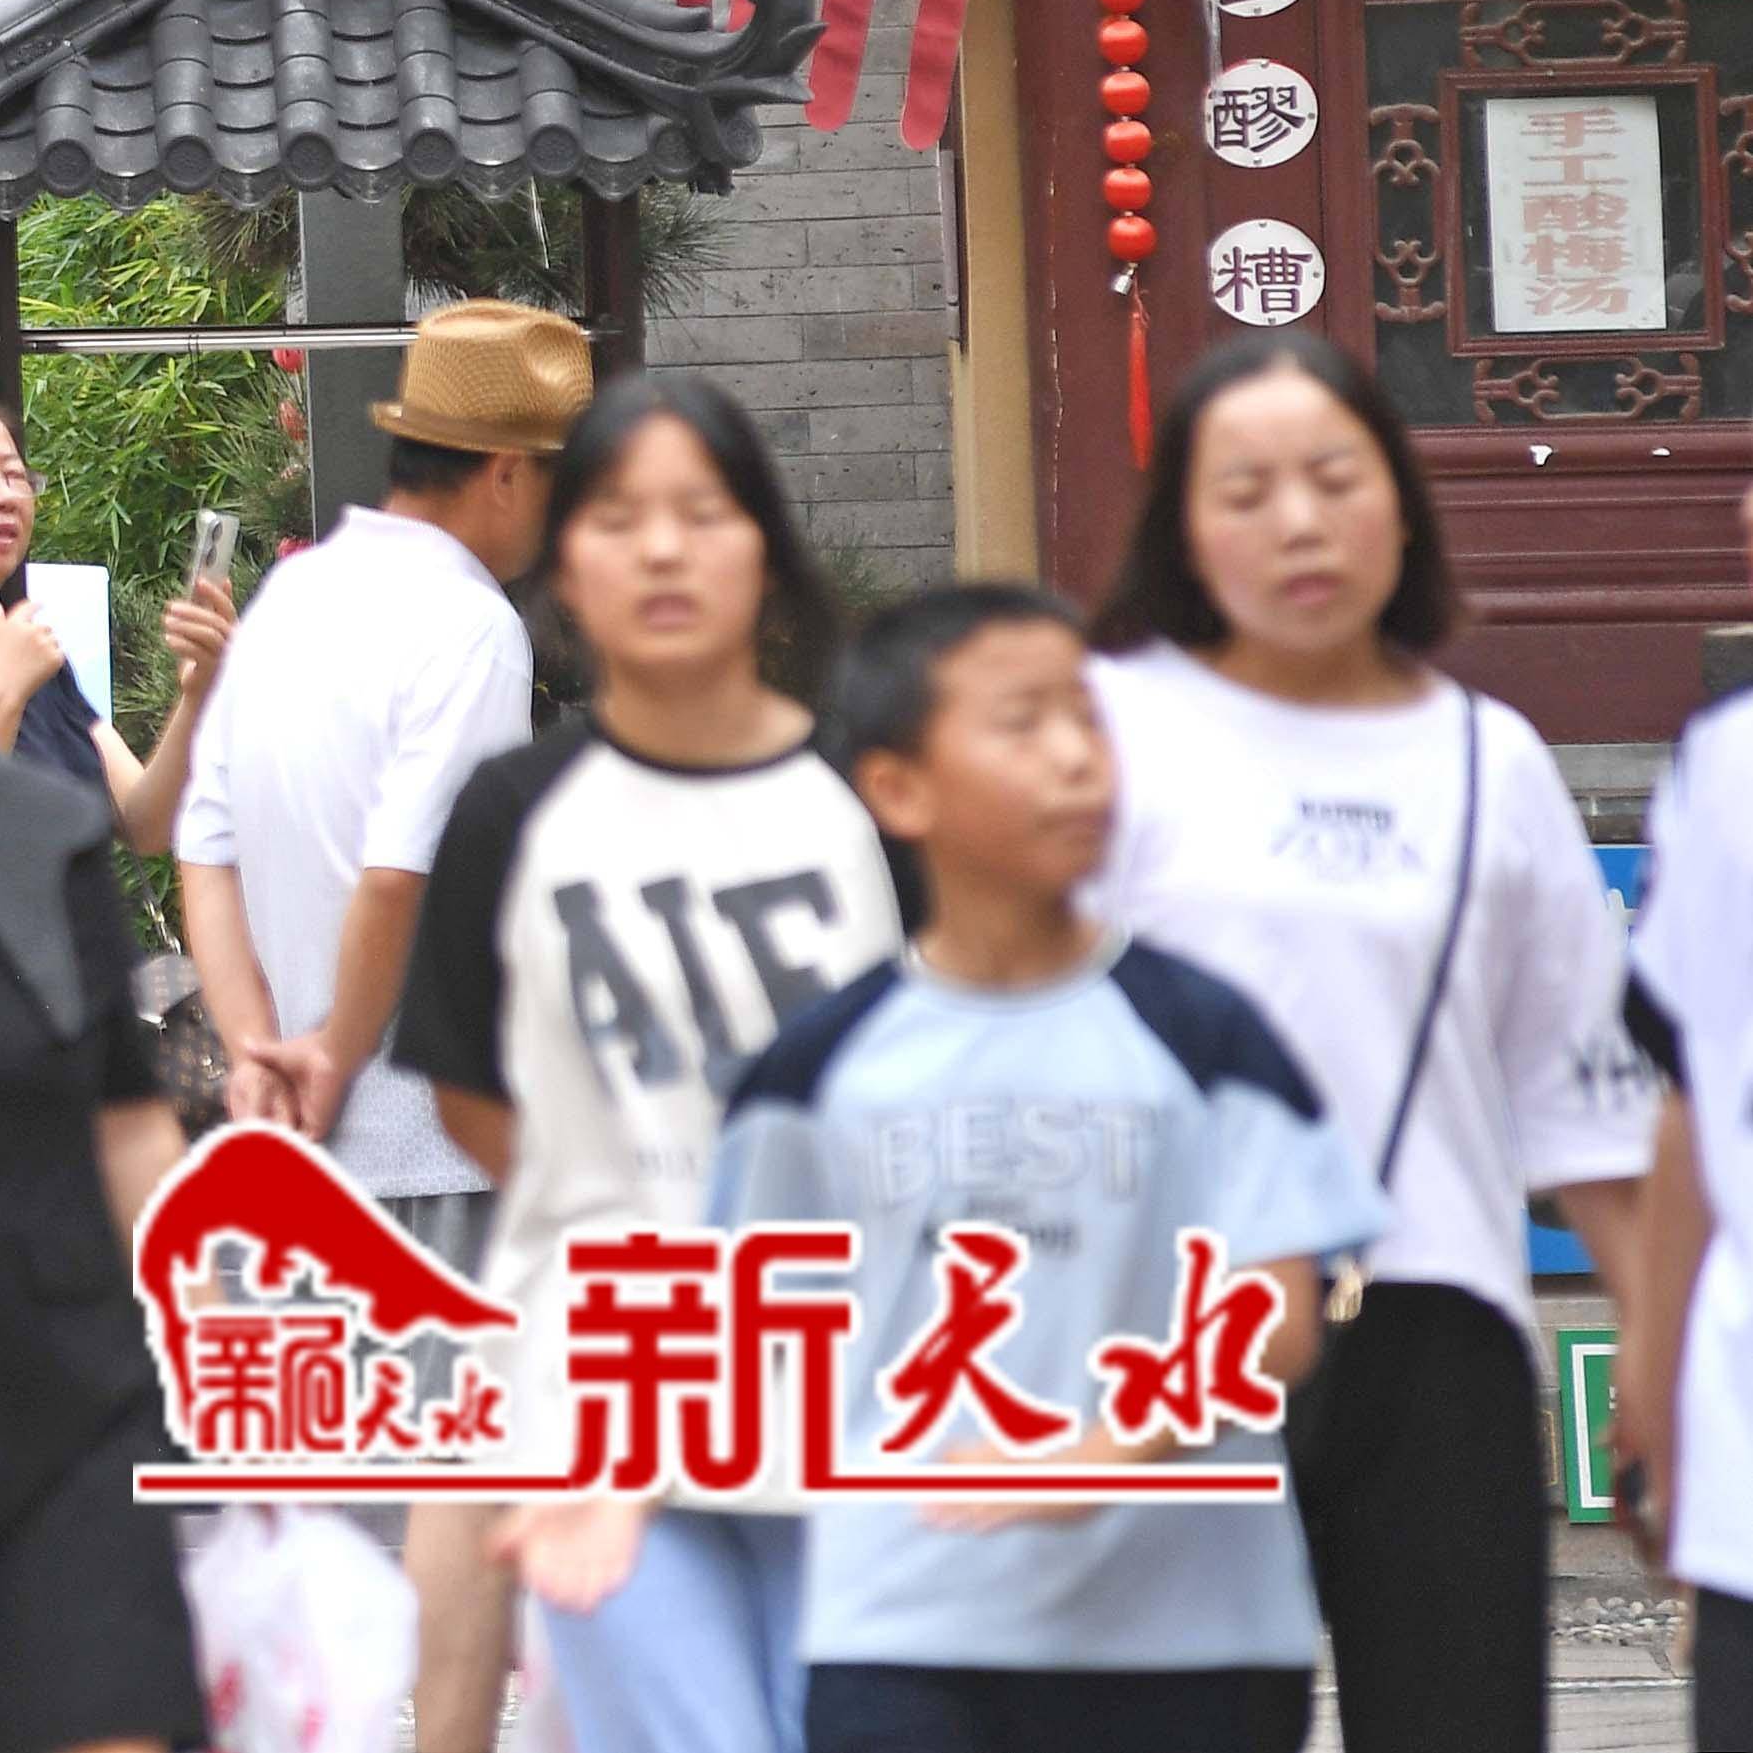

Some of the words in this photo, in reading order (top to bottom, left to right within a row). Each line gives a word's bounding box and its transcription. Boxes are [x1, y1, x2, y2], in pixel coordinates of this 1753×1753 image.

[1521, 106, 1631, 317] 手工酸梅汤
[871, 1098, 1157, 1210] BEST
